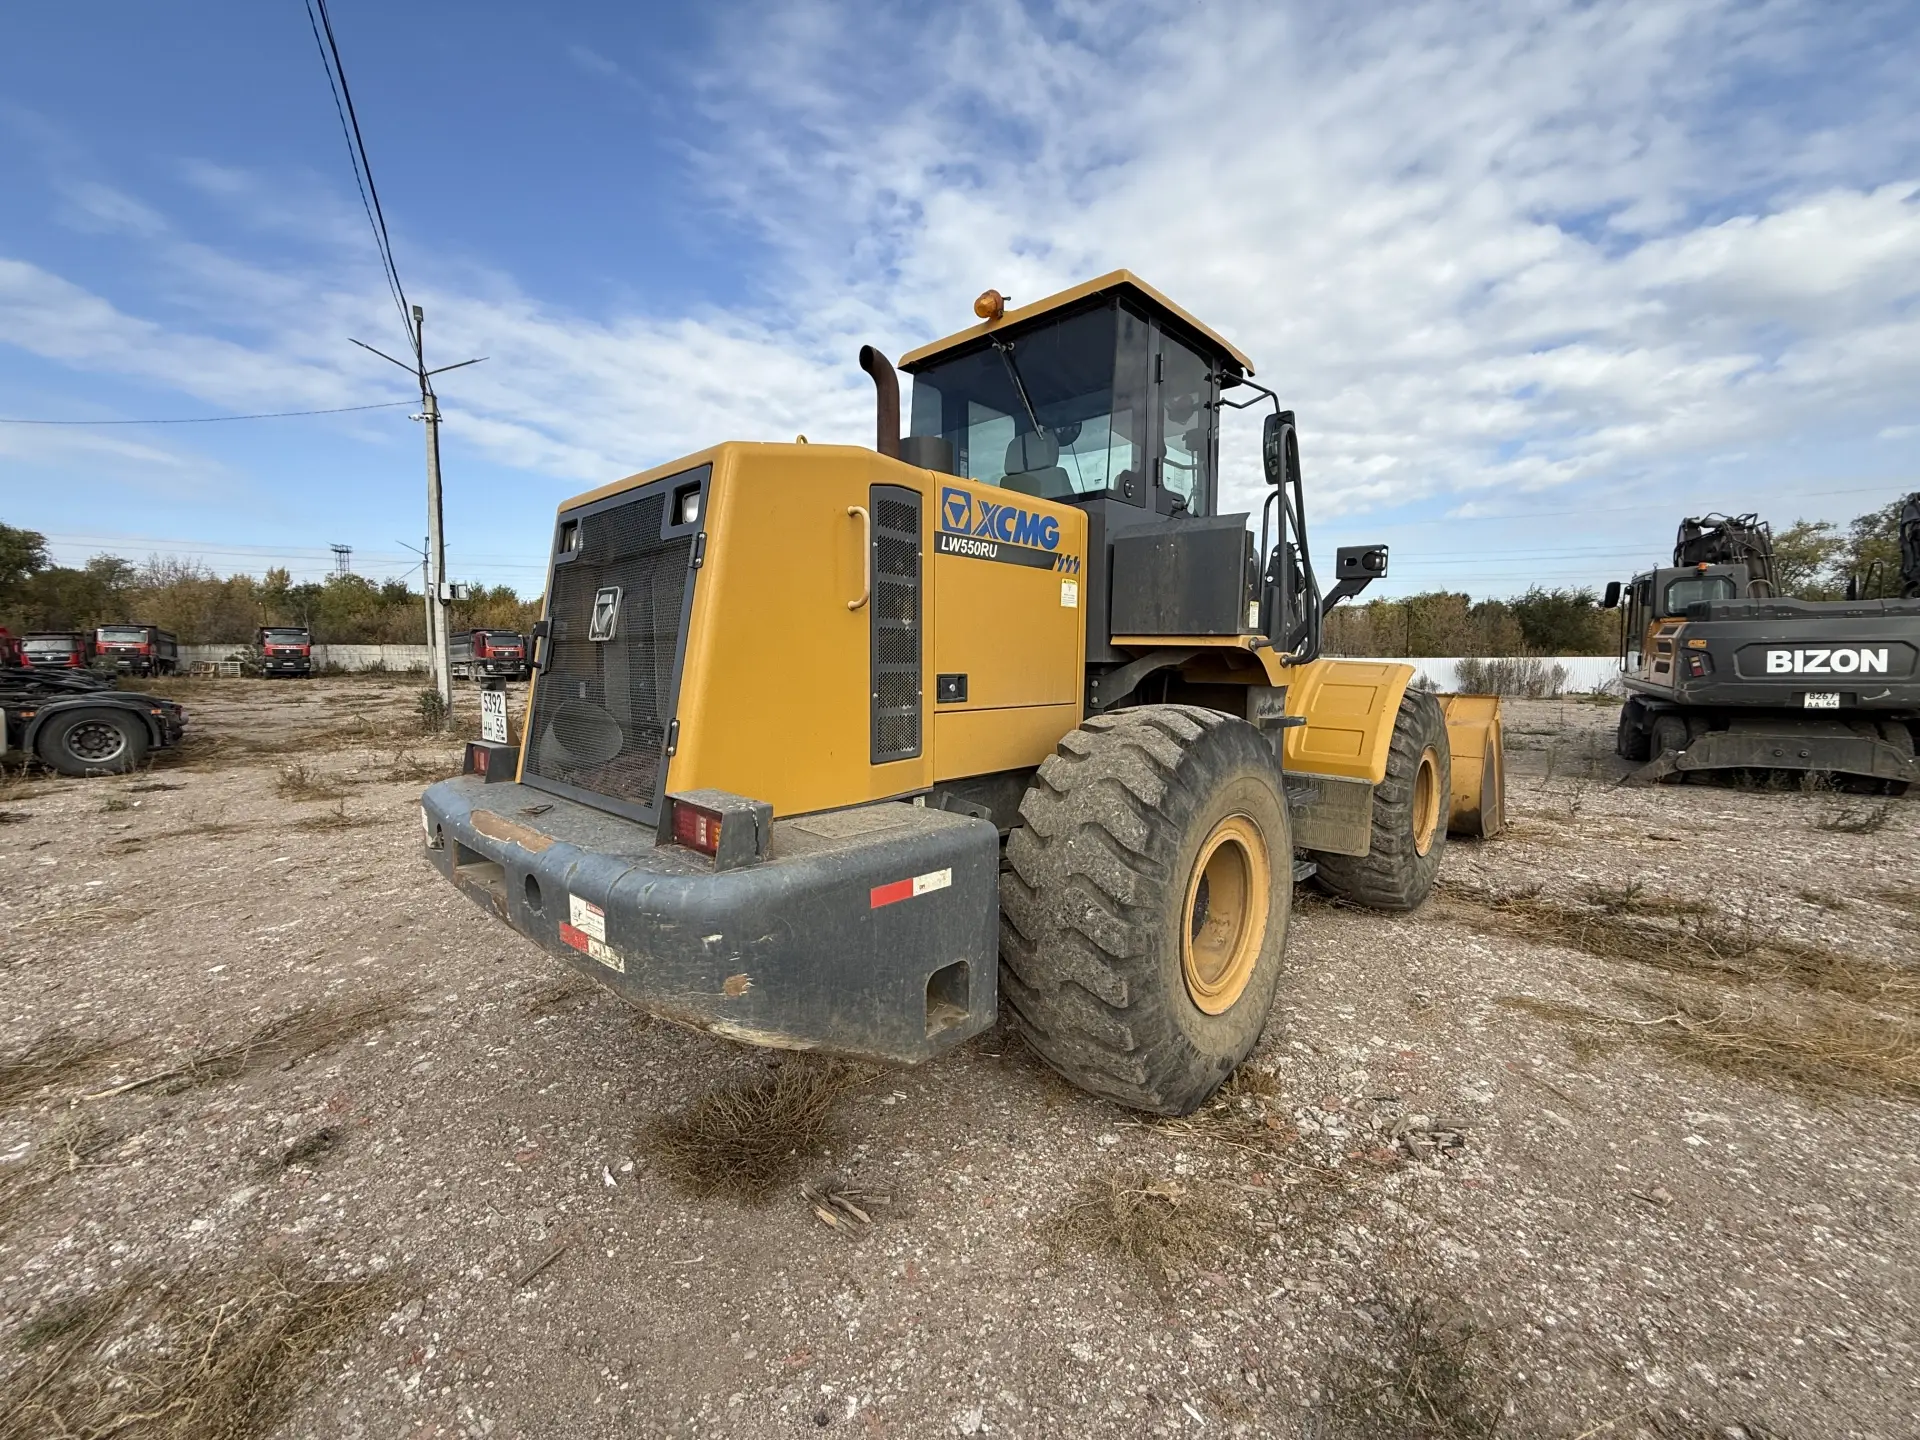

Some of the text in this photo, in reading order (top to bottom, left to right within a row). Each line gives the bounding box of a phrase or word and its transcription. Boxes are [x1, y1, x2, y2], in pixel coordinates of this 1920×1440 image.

[971, 500, 1060, 551] XCMG
[941, 536, 998, 558] LW550RU
[1766, 648, 1888, 673] BIZON
[484, 693, 502, 714] 5392
